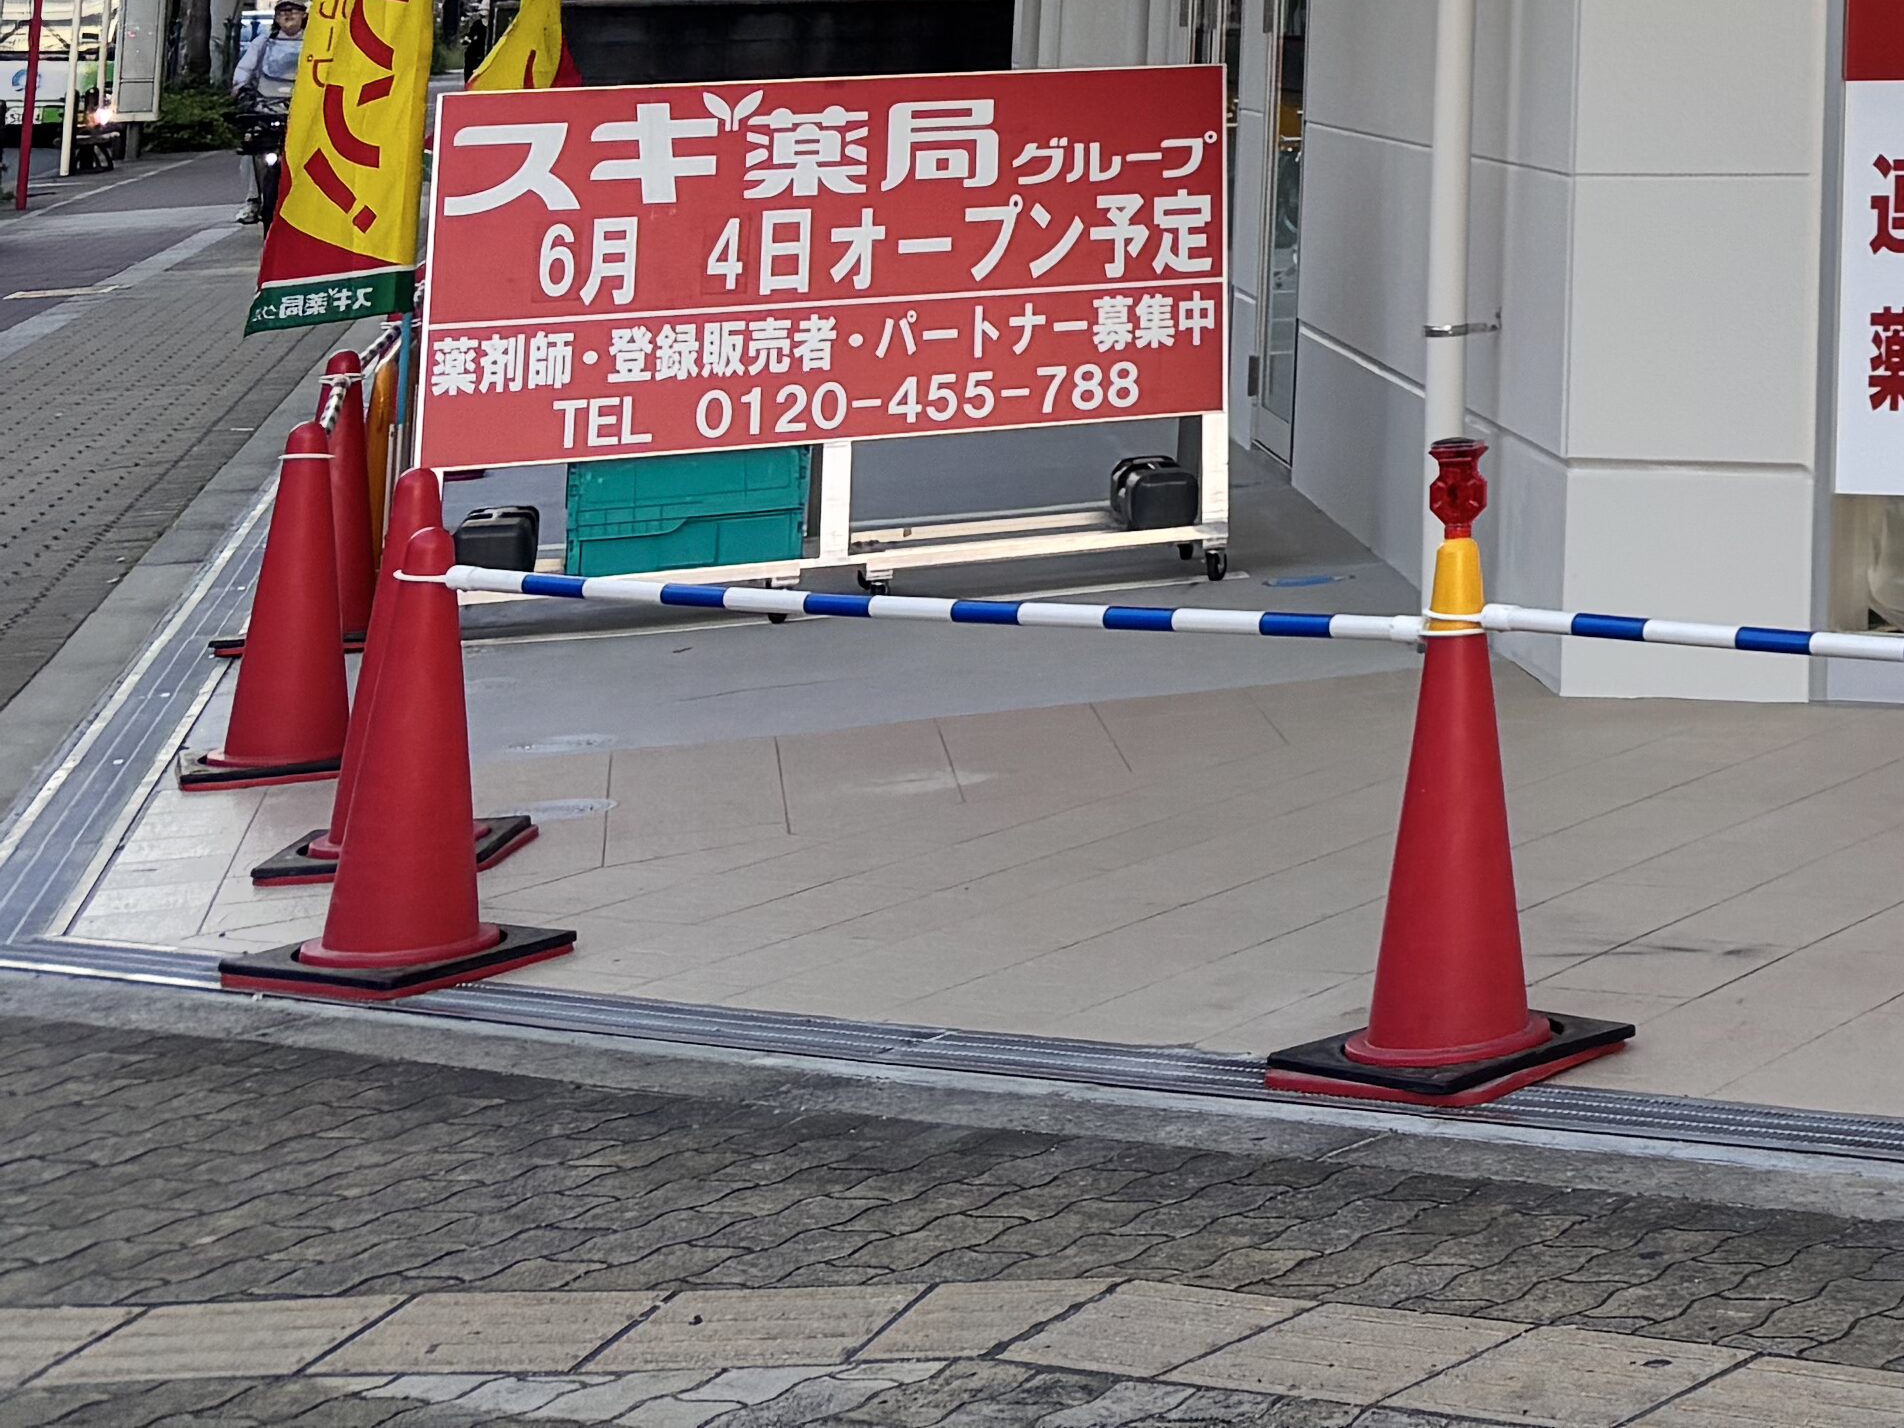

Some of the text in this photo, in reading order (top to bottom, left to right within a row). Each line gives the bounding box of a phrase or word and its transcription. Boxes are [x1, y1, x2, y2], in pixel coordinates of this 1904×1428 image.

[432, 290, 1216, 397] 薬剤師・登録販売者・パートナー募集中
[552, 360, 1140, 448] TEL 0120-455-788
